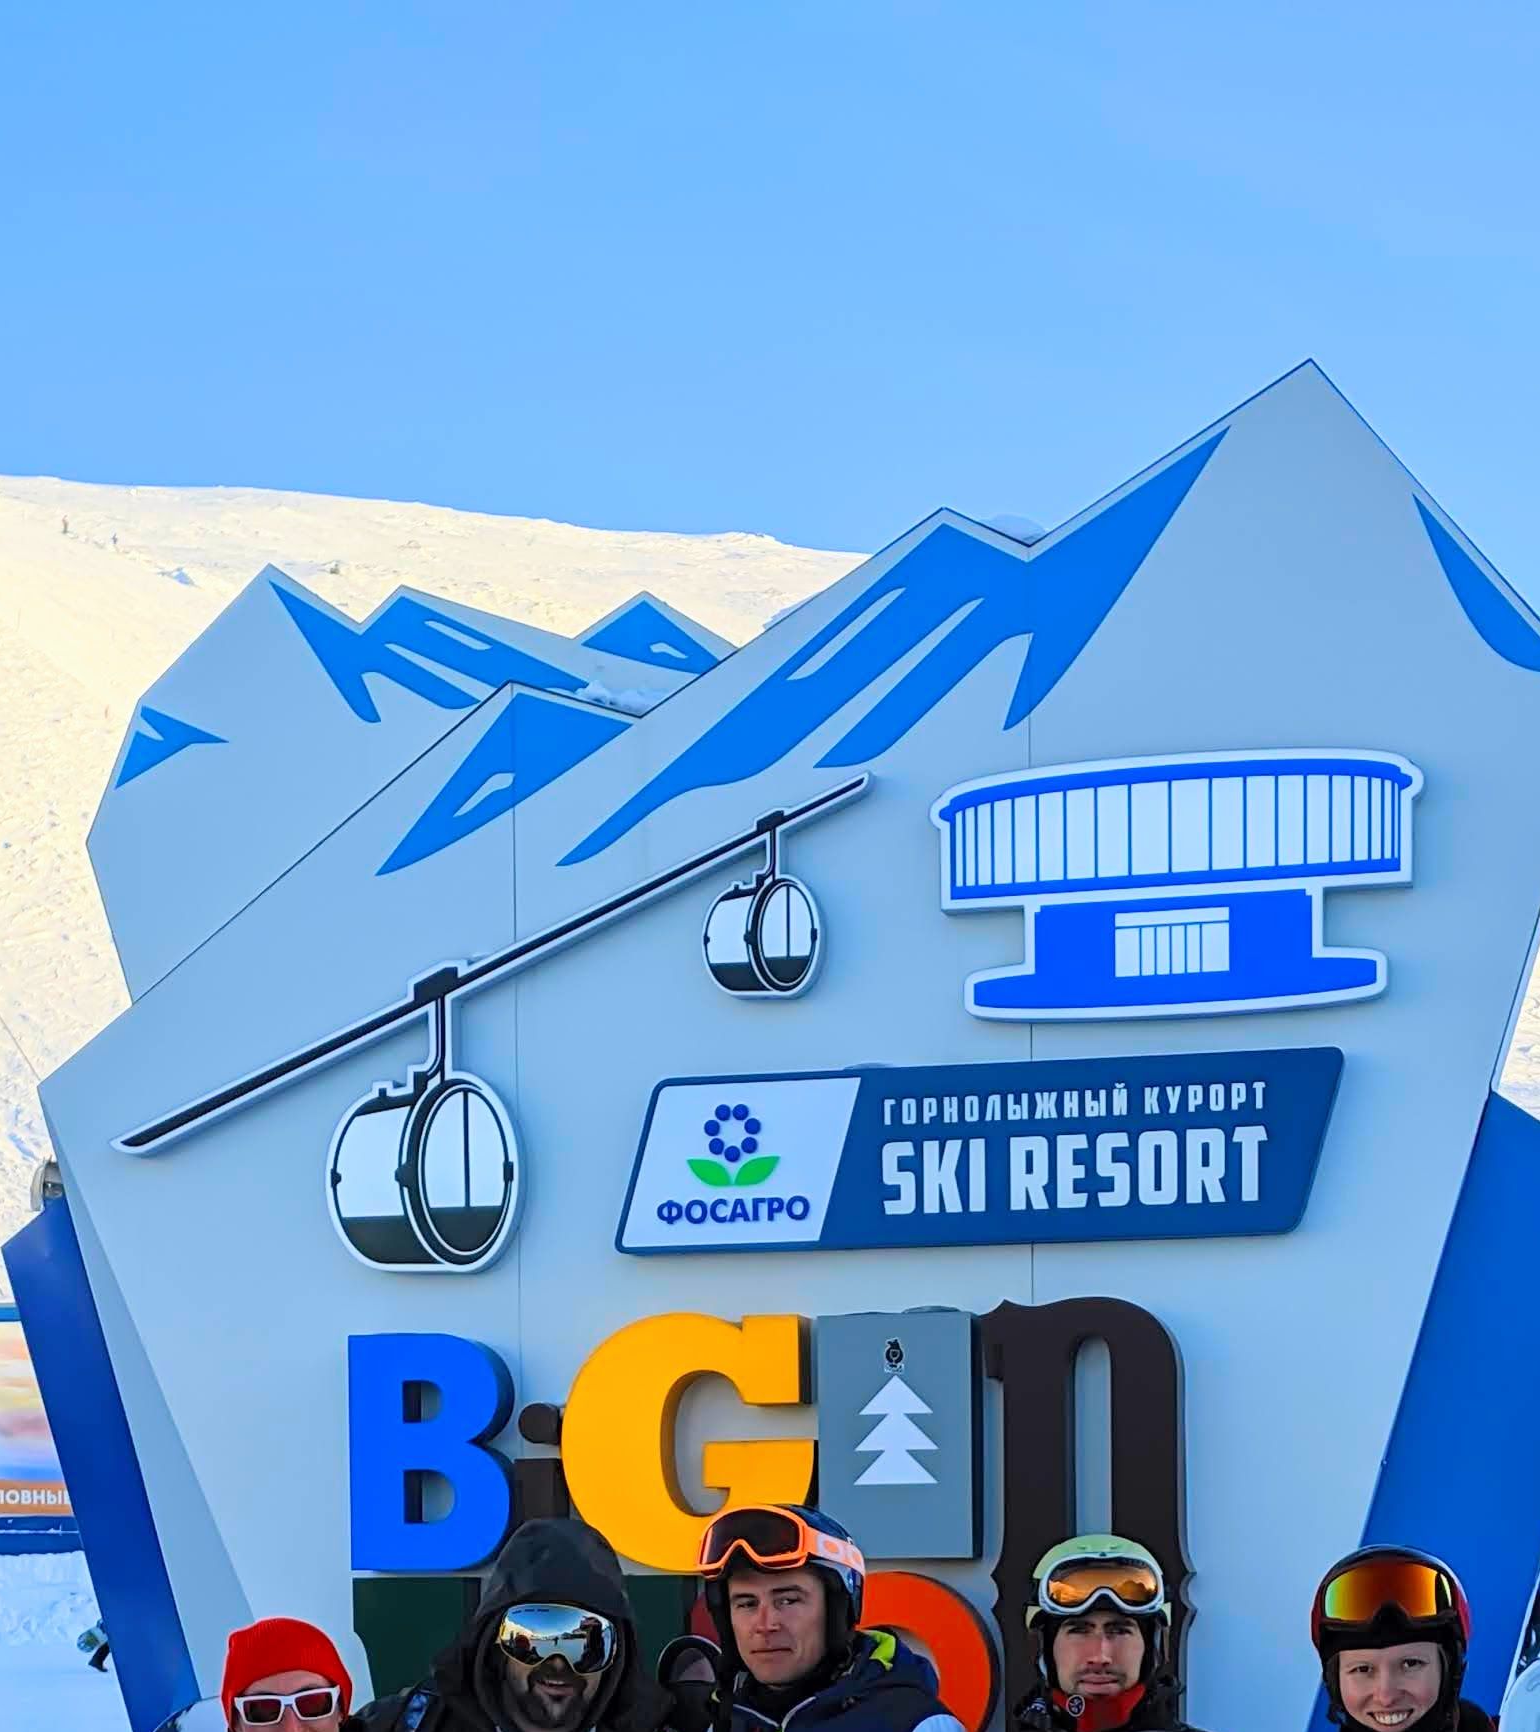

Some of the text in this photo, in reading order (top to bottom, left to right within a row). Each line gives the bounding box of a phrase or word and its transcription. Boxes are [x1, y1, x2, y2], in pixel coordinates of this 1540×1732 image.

[883, 1081, 1267, 1125] ГОРНОЛЫЖНЫЙ КУРОРТ
[882, 1125, 1269, 1216] SKI RESORT
[656, 1194, 811, 1227] ФОСАГРО
